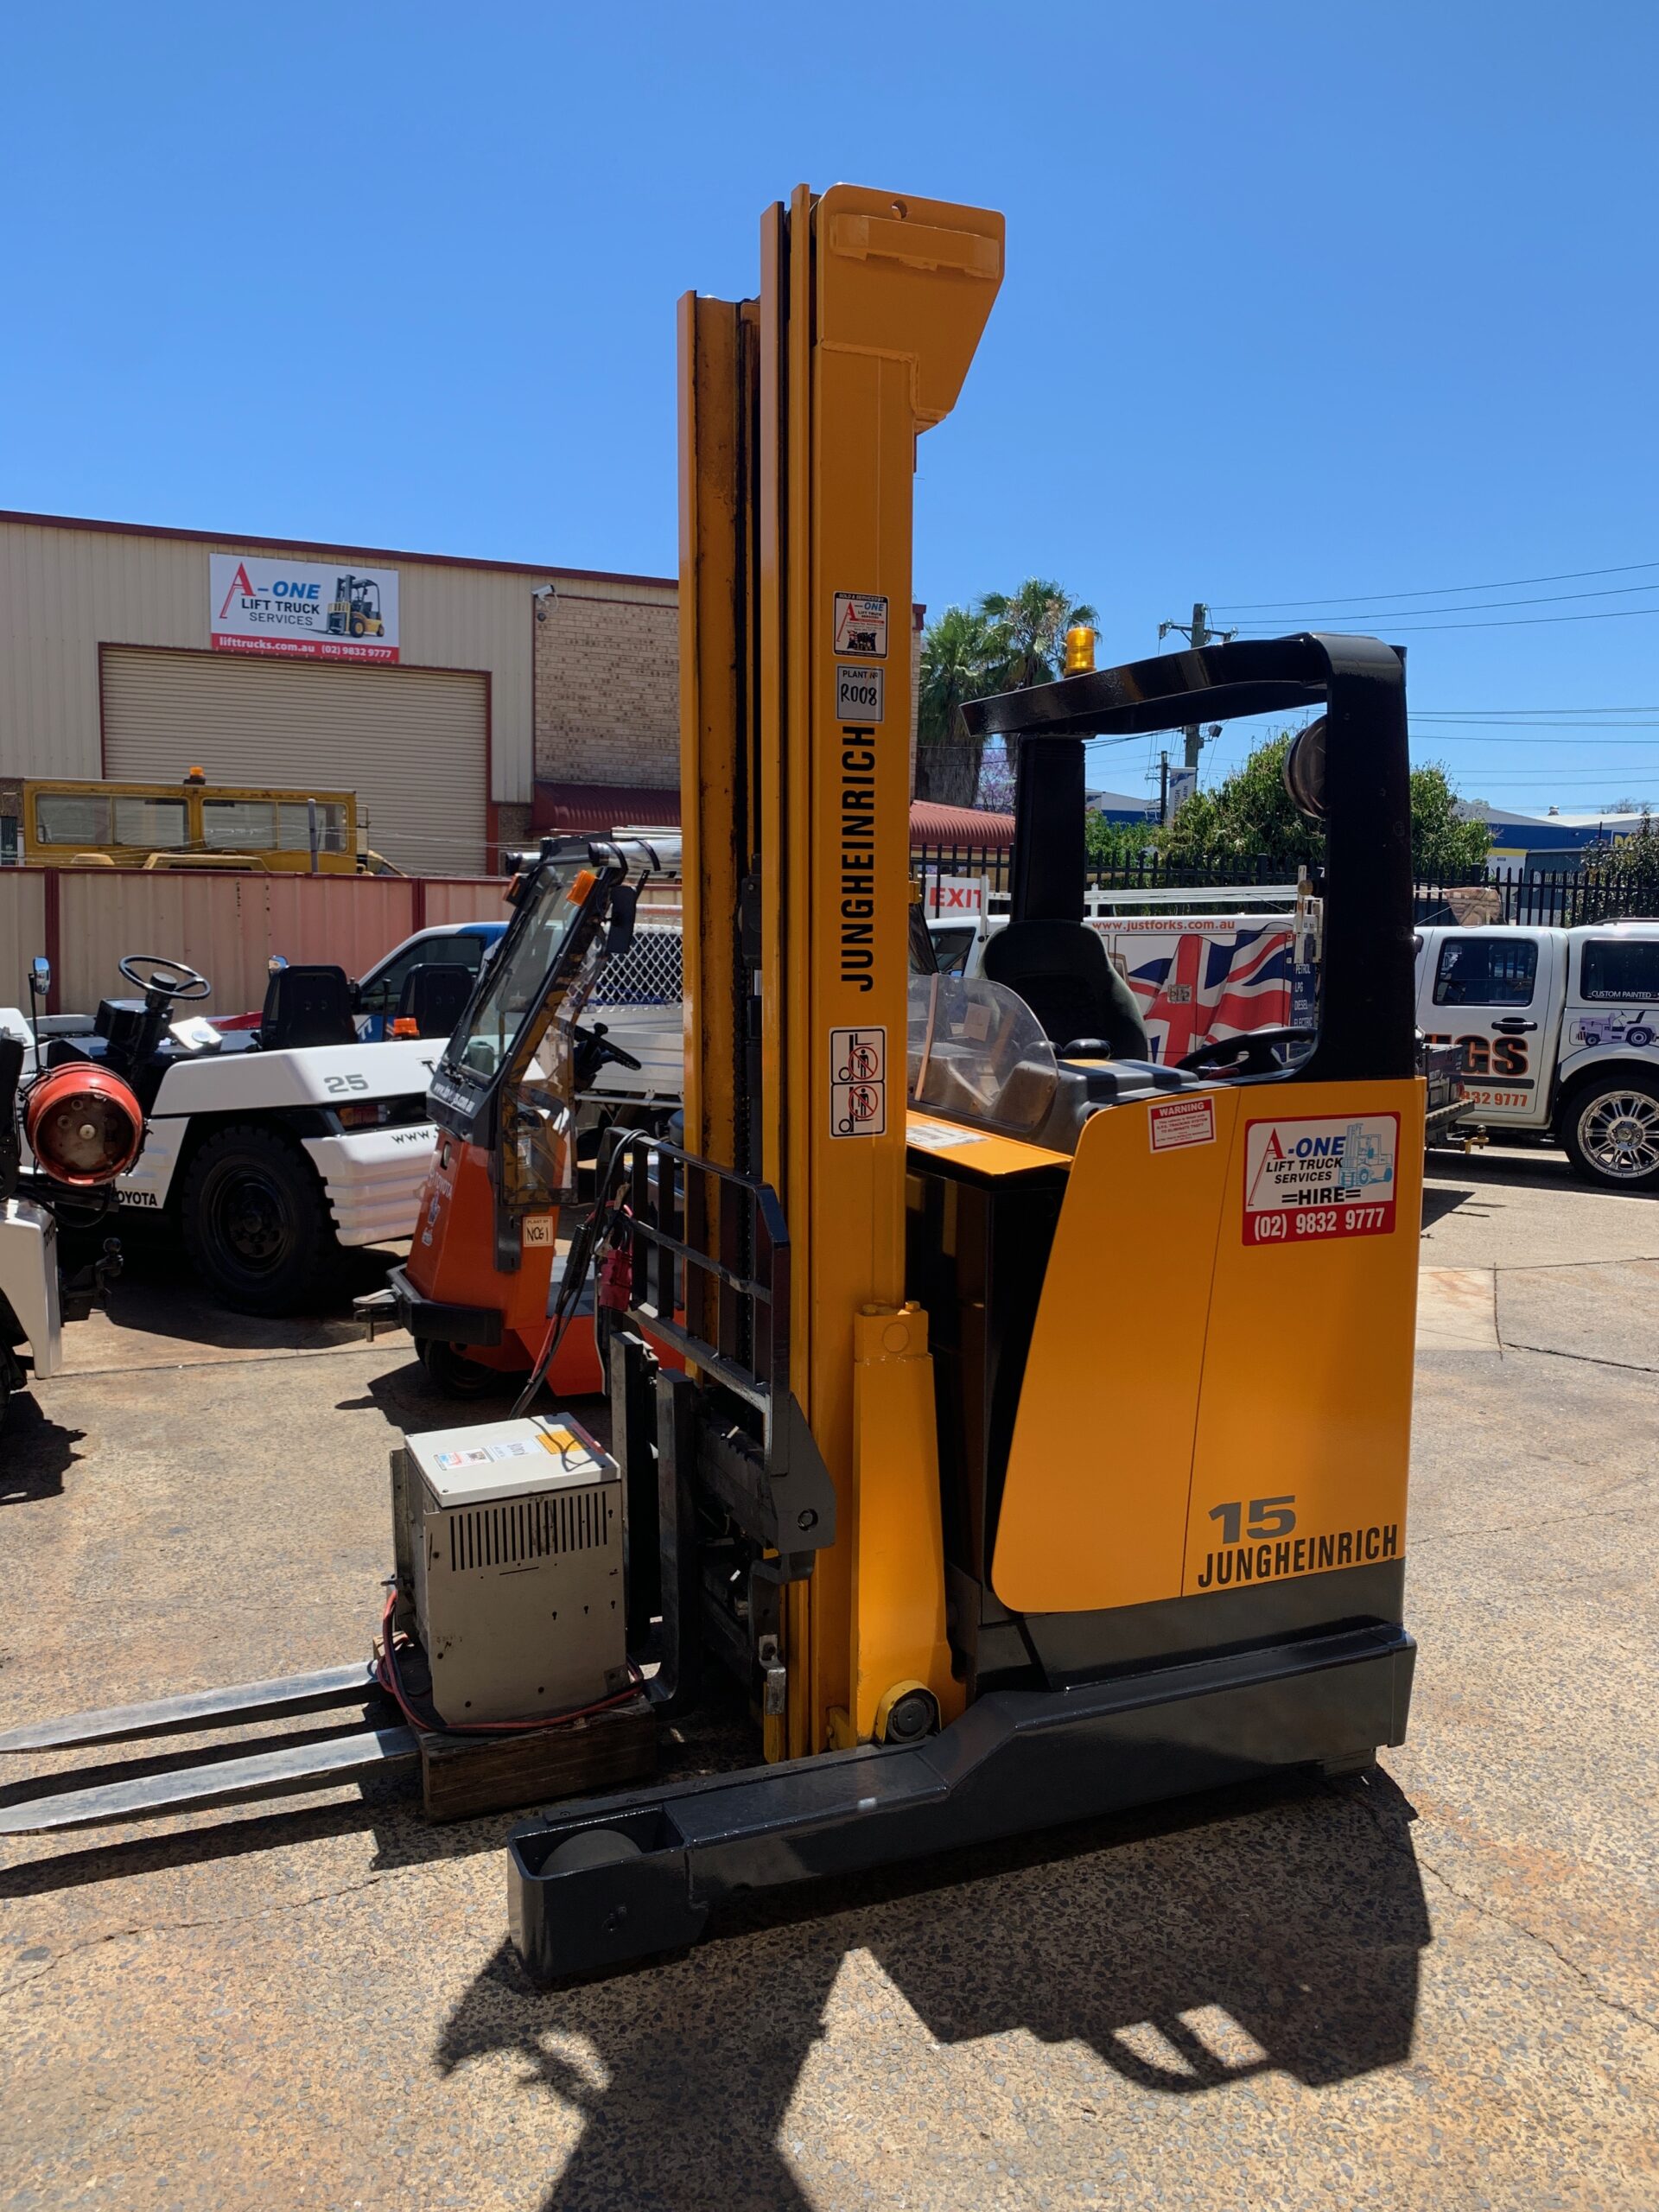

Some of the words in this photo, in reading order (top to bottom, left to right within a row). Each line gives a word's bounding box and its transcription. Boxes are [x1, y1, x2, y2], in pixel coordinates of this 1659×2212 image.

[241, 599, 271, 611] LIFT
[275, 601, 320, 614] TRUCK
[250, 612, 313, 626] SERVICES
[219, 637, 315, 653] lifttrucks.com.au
[321, 645, 340, 655] (02)
[342, 645, 366, 657] 9832
[368, 648, 391, 658] 9777
[842, 670, 868, 678] PLANT
[841, 683, 877, 706] R008
[841, 726, 875, 992] JUNGHEINRICH
[929, 887, 982, 909] EXIT
[1092, 920, 1236, 932] www.justforks.com.au
[1295, 963, 1311, 975] PETROL
[1294, 982, 1303, 993] LPG
[1294, 1000, 1308, 1011] DIESEL
[323, 1074, 369, 1094] 25
[1494, 1092, 1528, 1107] 9777
[1160, 1102, 1205, 1117] WARNING
[1266, 1160, 1295, 1173] LIFT
[1299, 1157, 1344, 1171] TRUCK
[1274, 1171, 1332, 1185] SERVICES
[117, 1190, 157, 1206] OYOTA
[1254, 1213, 1287, 1241] (02)
[1296, 1211, 1337, 1235] 9832
[1345, 1207, 1385, 1230] 9777
[1208, 1496, 1296, 1544] 15
[1198, 1524, 1397, 1588] JUNGHEINRICH
